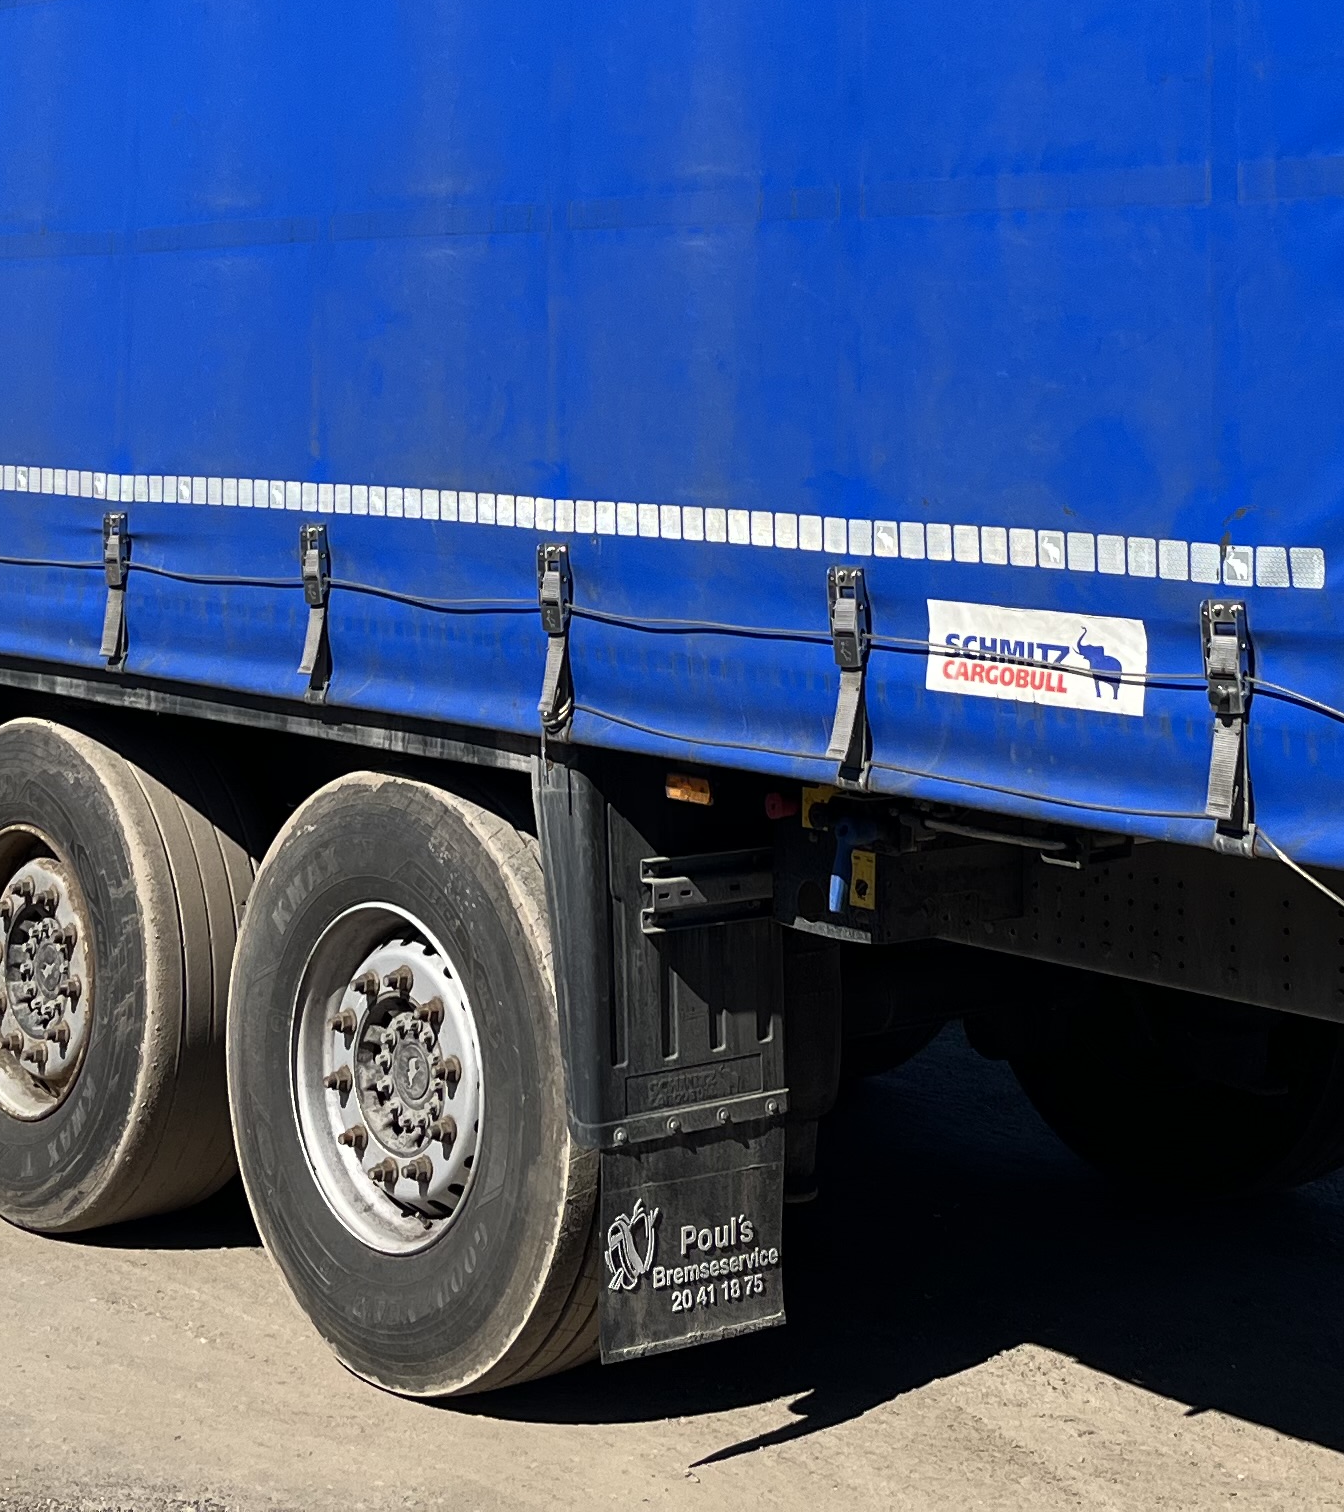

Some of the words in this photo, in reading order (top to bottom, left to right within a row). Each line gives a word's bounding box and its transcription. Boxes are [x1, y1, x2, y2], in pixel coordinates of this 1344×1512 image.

[944, 632, 1071, 669] SCHMITZ
[942, 659, 1068, 693] CARGOBULL
[653, 1247, 779, 1288] Bremseservice
[671, 1289, 692, 1312] 20
[696, 1284, 715, 1305] 41
[721, 1279, 741, 1301] 18
[744, 1274, 764, 1295] 75
